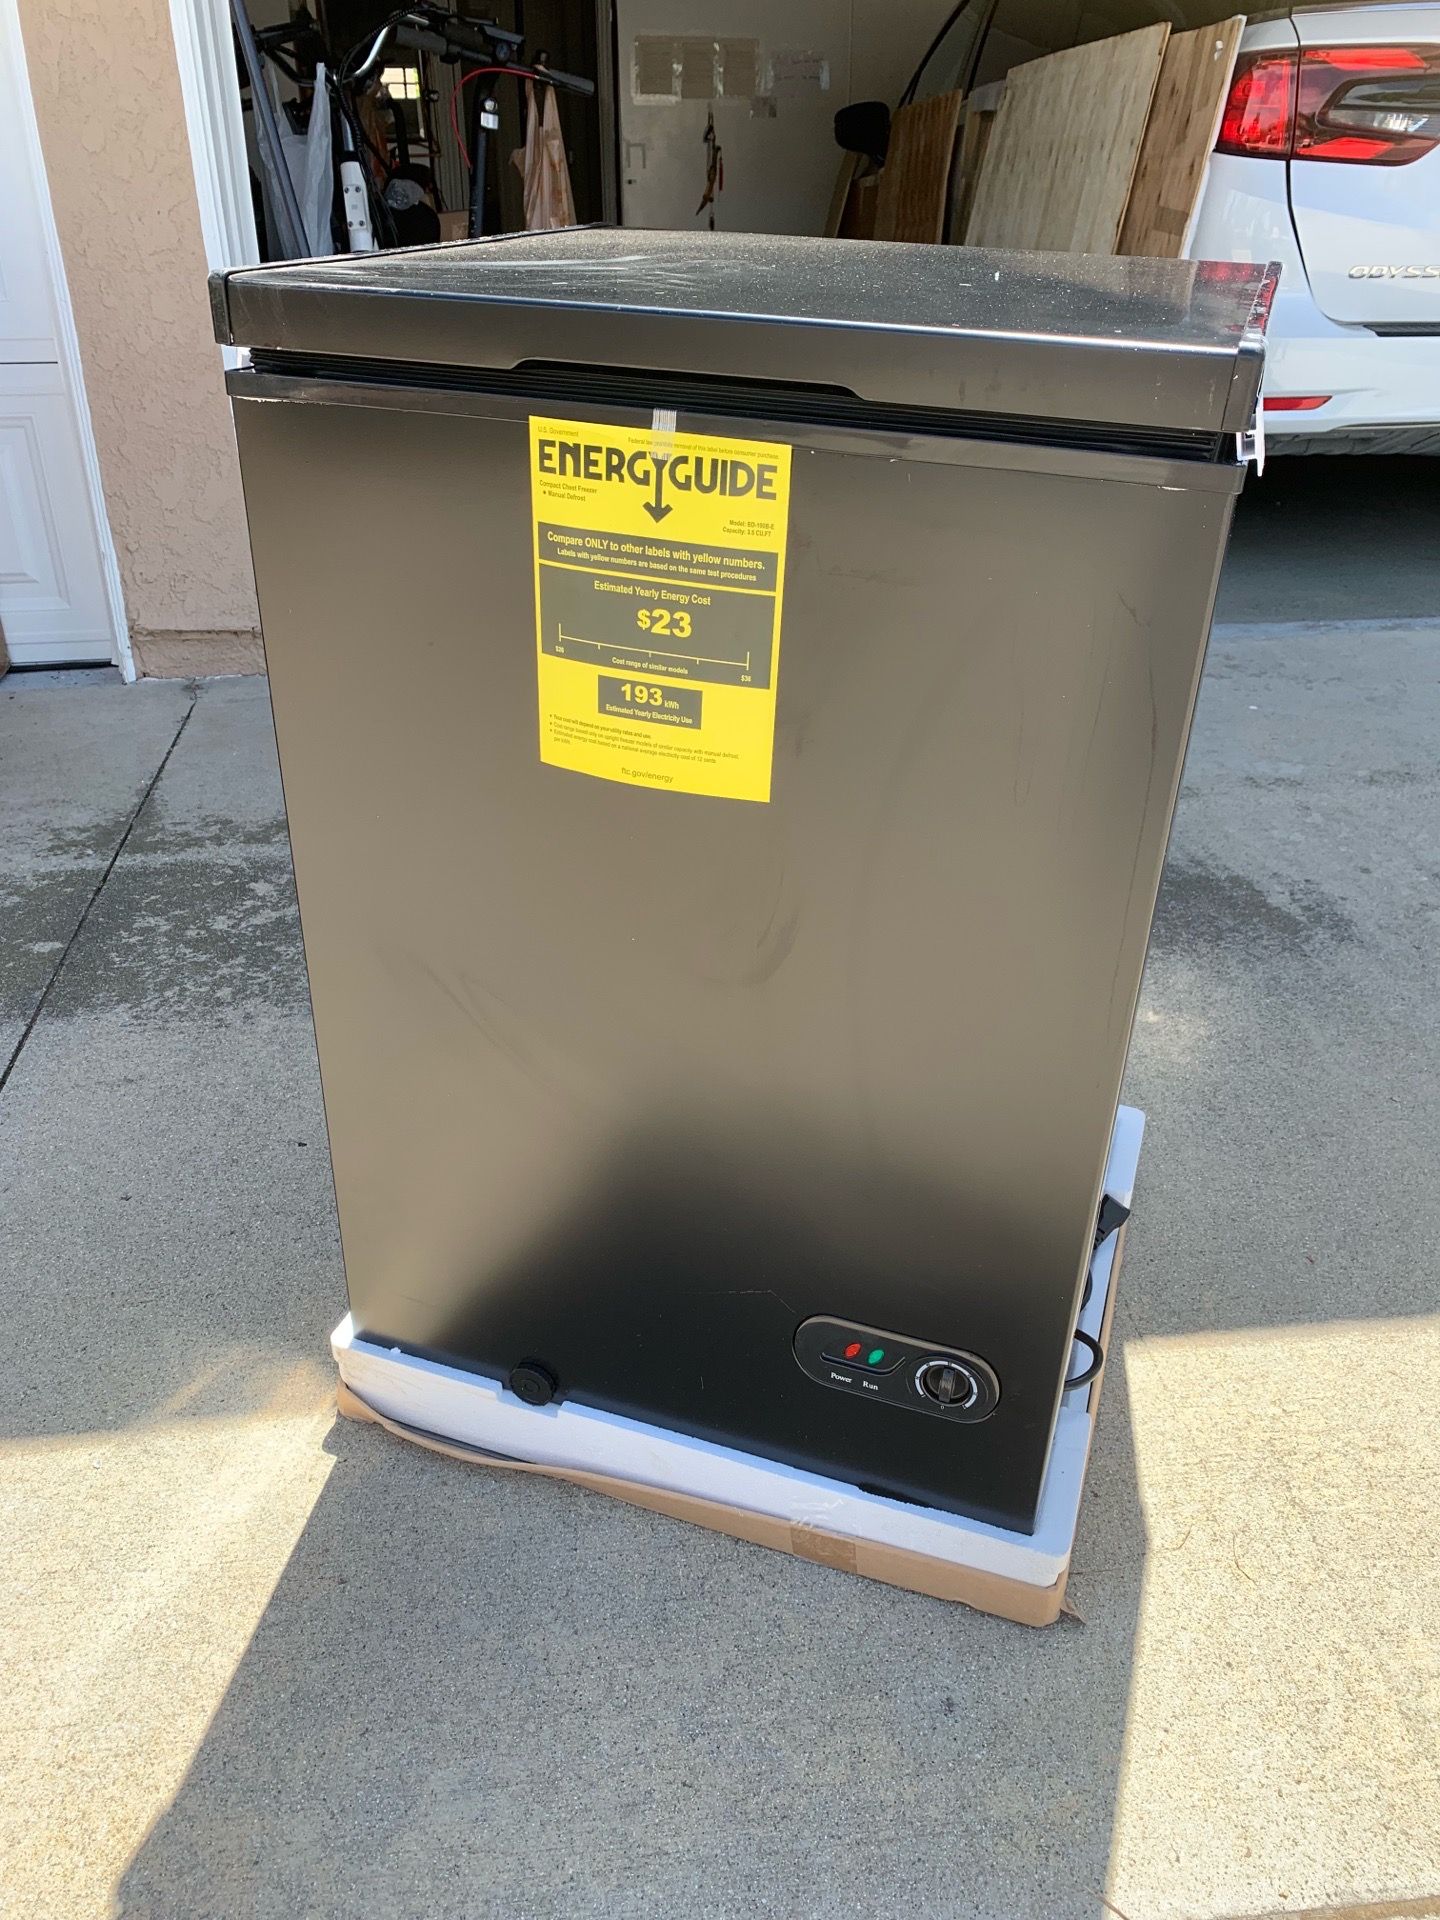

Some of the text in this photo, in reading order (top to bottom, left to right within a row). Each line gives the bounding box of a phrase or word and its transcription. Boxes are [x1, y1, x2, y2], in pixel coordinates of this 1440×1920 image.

[1348, 264, 1440, 278] ODYSS
[549, 427, 579, 436] Government
[538, 439, 777, 500] ENERGYGUIDE
[539, 480, 597, 494] Compact Chest Freezer
[548, 490, 586, 501] Manual Defrost
[722, 526, 745, 535] Capacity:
[729, 519, 746, 527] Model:
[547, 531, 765, 570] Compare ONLY to other labels with yellow numbers.
[557, 547, 576, 557] Labels
[577, 551, 590, 559] with
[590, 553, 611, 562] yellow
[611, 557, 637, 566] numbers
[638, 560, 648, 568] are
[649, 562, 668, 570] based
[678, 565, 688, 573] the
[689, 568, 706, 576] same
[594, 580, 711, 605] Estimated Yearly Energy Cost
[636, 608, 692, 638] $23
[611, 657, 625, 665] Cost
[626, 660, 641, 669] range
[649, 663, 667, 671] similar
[668, 667, 688, 675] models
[621, 683, 679, 710] 193 kWh
[606, 704, 693, 725] Estimated Yearly Electricity Use
[621, 767, 674, 784] ftc.gov/energy
[830, 1371, 879, 1391] Power Run
